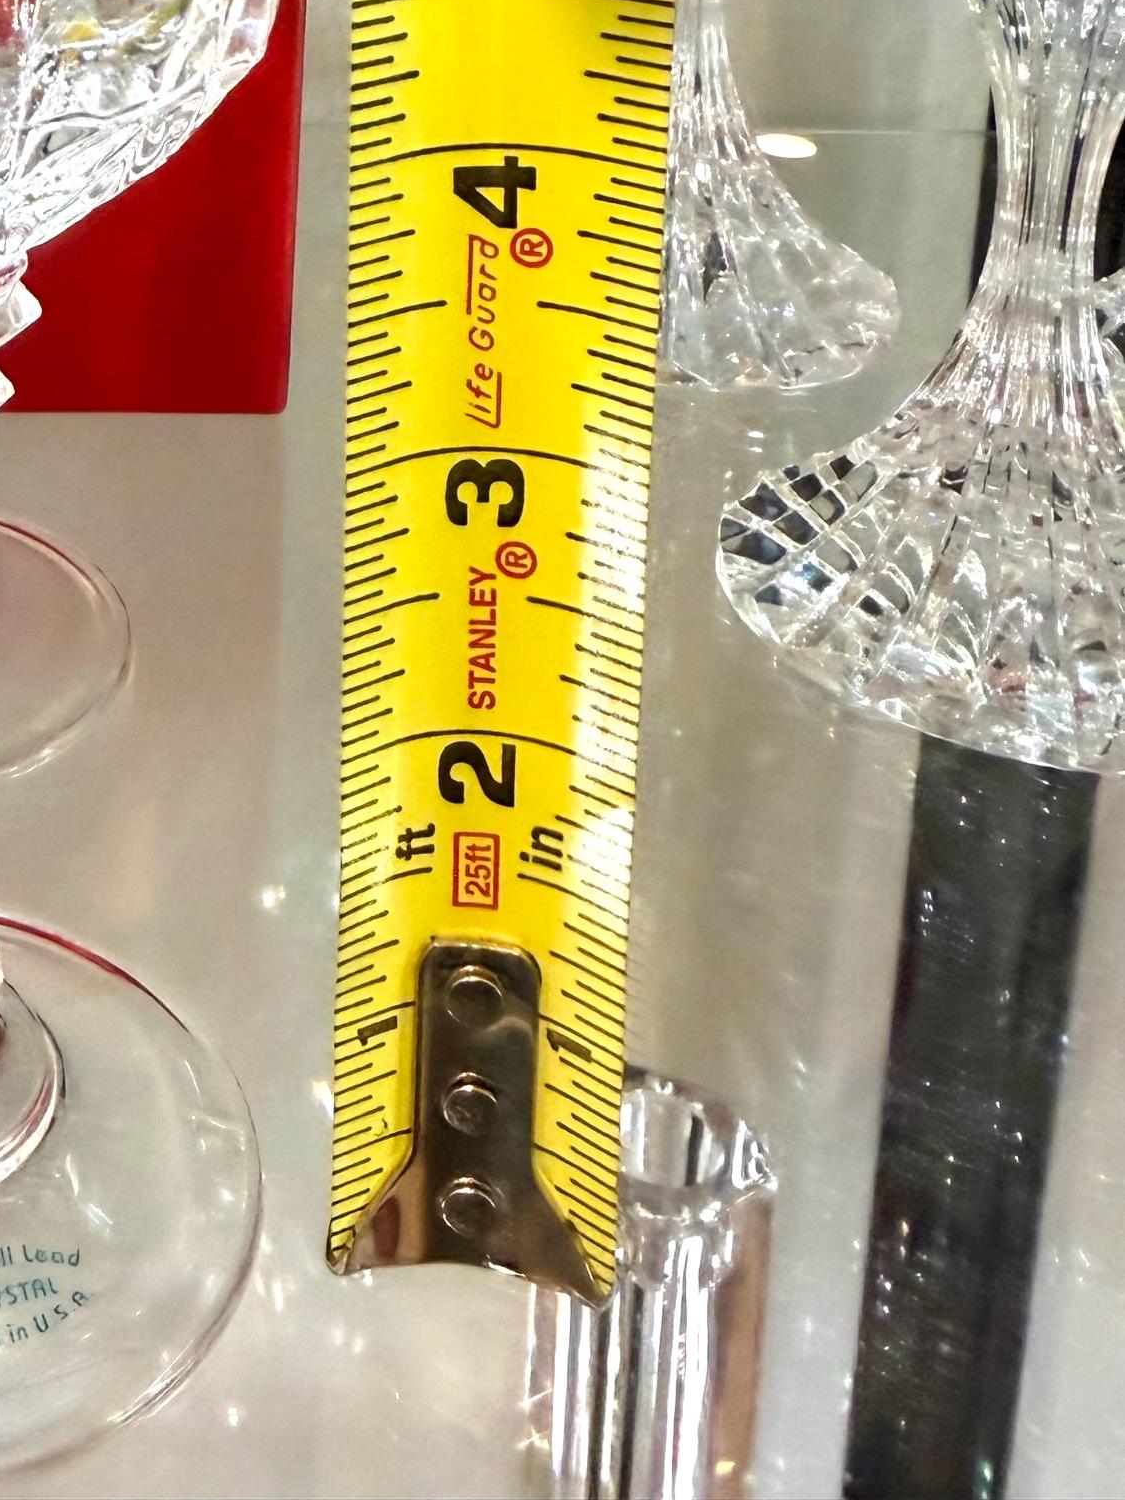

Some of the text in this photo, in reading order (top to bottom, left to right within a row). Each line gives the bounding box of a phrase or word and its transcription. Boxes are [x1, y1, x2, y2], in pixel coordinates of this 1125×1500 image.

[453, 155, 537, 229] 4
[444, 458, 526, 528] 3
[467, 566, 498, 710] STANLEY
[437, 740, 516, 809] 2
[395, 822, 436, 862] ft
[464, 842, 492, 897] 25ft
[519, 825, 565, 872] in
[6, 1322, 29, 1344] in
